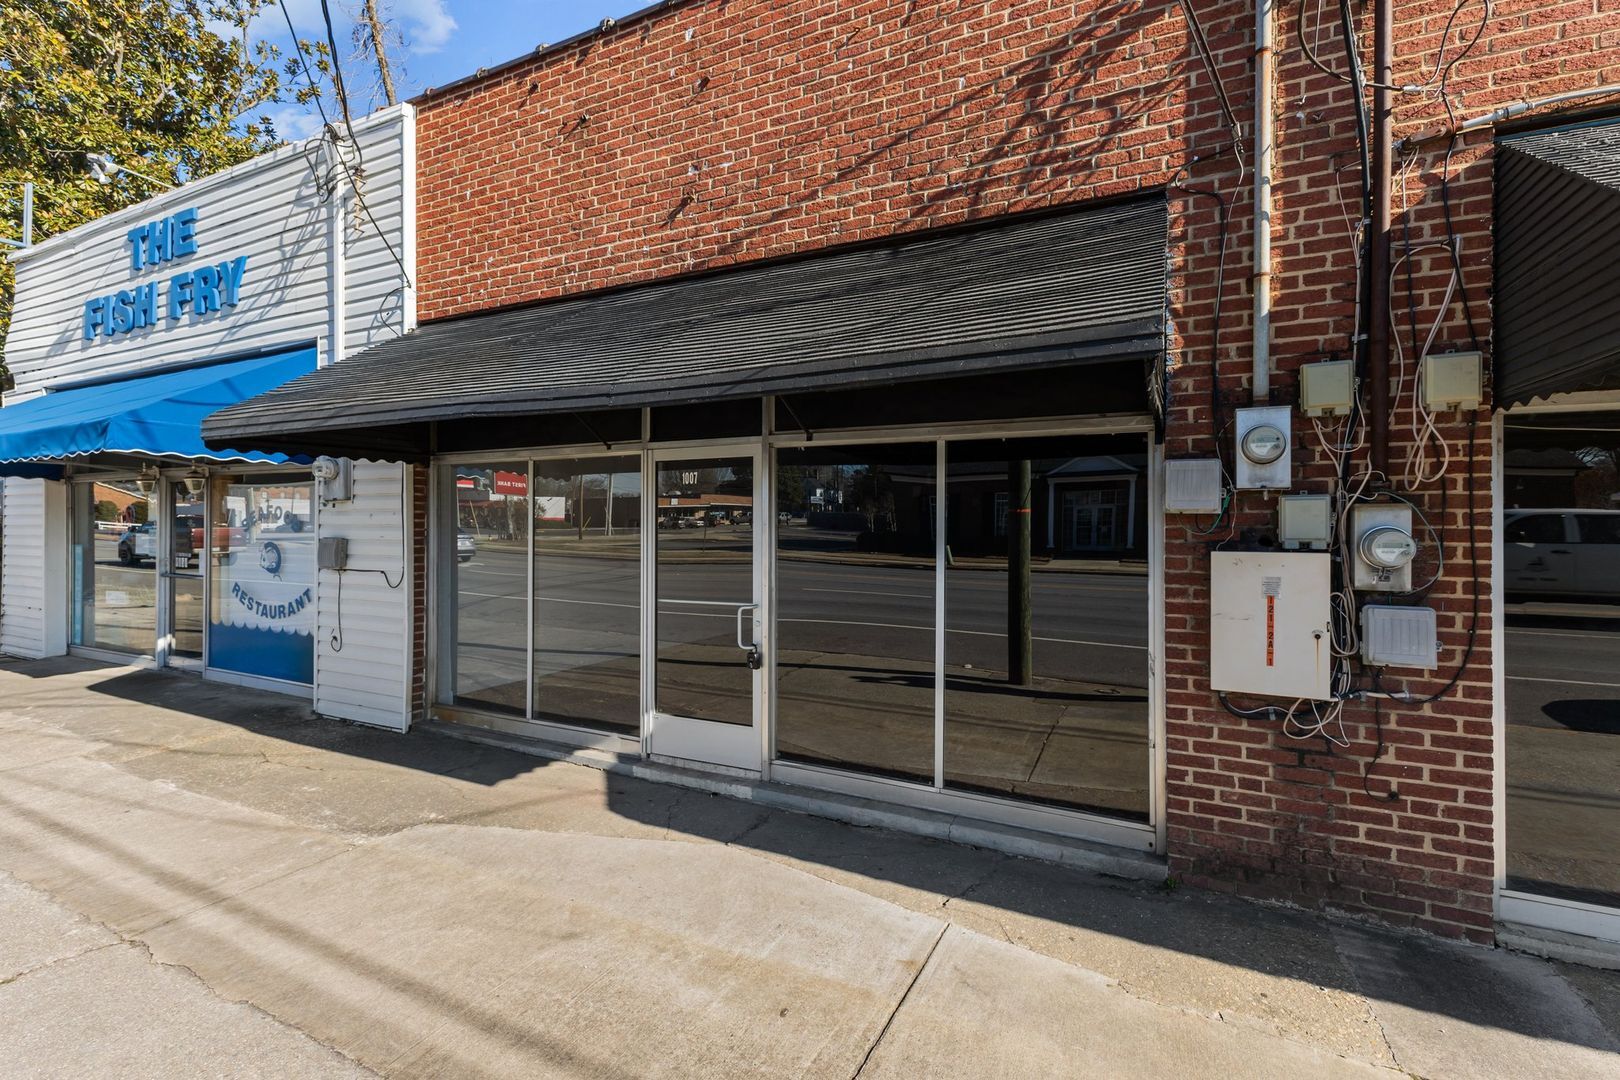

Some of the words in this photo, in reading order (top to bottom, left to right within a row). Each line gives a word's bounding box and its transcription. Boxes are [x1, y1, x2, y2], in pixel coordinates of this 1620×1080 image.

[127, 207, 199, 271] THE
[84, 281, 158, 341] FISH
[170, 256, 248, 320] FRY
[682, 472, 698, 485] 1007
[232, 582, 312, 619] RESTAURANT
